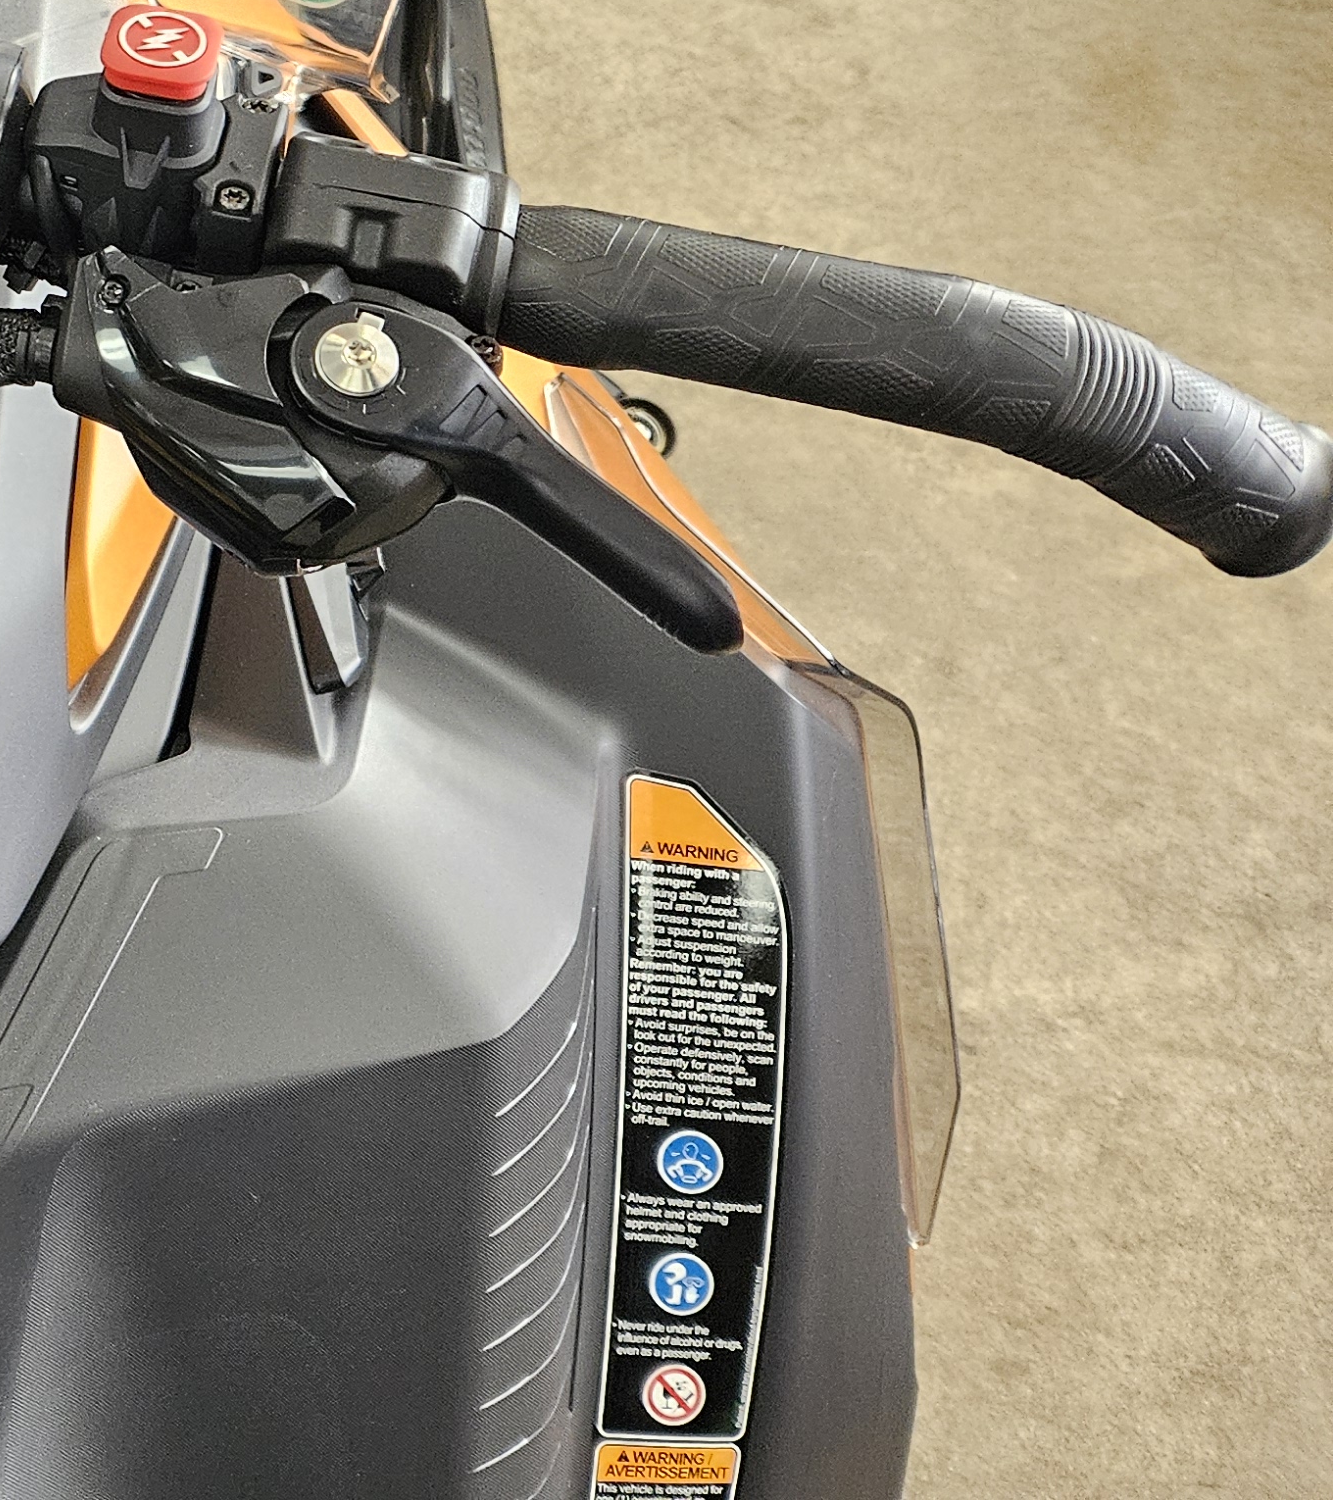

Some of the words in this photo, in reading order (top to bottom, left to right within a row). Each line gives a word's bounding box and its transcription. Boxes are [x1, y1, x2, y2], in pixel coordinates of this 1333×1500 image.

[658, 842, 738, 862] WARNING
[631, 860, 664, 873] When
[666, 863, 702, 878] riding
[703, 868, 729, 880] with
[631, 874, 695, 889] passenger:
[638, 886, 676, 900] Braking
[679, 891, 709, 905] ability
[711, 895, 731, 905] and
[733, 897, 774, 911] steering
[638, 898, 672, 910] control
[675, 903, 692, 912] are
[694, 904, 738, 917] reduced.
[667, 926, 700, 939] space
[702, 929, 713, 939] to
[691, 916, 724, 929] speed
[727, 920, 747, 930] and
[750, 922, 778, 934] allow
[636, 947, 688, 961] according
[691, 952, 702, 962] to
[704, 954, 743, 968] weight.
[673, 940, 736, 954] suspension
[629, 958, 695, 974] Remember:
[698, 967, 720, 978] you
[723, 969, 742, 979] are
[628, 980, 640, 991] of
[642, 984, 668, 995] your
[671, 987, 736, 1003] passenger.
[740, 992, 756, 1003] All
[629, 970, 696, 986] responsible
[699, 976, 715, 987] for
[718, 979, 738, 990] the
[740, 981, 776, 996] safety
[628, 993, 668, 1006] drivers
[671, 997, 694, 1008] and
[696, 1001, 764, 1017] passengers
[628, 1005, 657, 1016] must
[659, 1008, 686, 1019] read
[688, 1010, 707, 1021] the
[709, 1012, 767, 1029] following:
[634, 1018, 665, 1030] Avoid
[667, 1022, 720, 1036] surprises,
[723, 1027, 738, 1037] be
[740, 1030, 754, 1038] on
[757, 1030, 774, 1041] the
[634, 1030, 655, 1040] look
[658, 1033, 675, 1042] out
[677, 1033, 691, 1044] for
[694, 1035, 711, 1046] the
[713, 1038, 776, 1053] unexpected.
[634, 1041, 678, 1056] Operate
[746, 1054, 773, 1065] scan
[633, 1054, 688, 1070] constantly
[691, 1059, 705, 1070] for
[708, 1062, 748, 1076] people,
[633, 1066, 674, 1080] objects,
[677, 1070, 733, 1084] conditions
[735, 1075, 756, 1086] and
[633, 1078, 685, 1093] upcoming
[688, 1083, 734, 1096] vehicles.
[632, 1089, 662, 1101] Avoid
[664, 1092, 684, 1103] thin
[687, 1094, 703, 1105] ice
[711, 1098, 739, 1110] open
[741, 1100, 774, 1112] water.
[632, 1102, 652, 1113] Use
[655, 1105, 681, 1116] extra
[683, 1108, 721, 1120] caution
[723, 1111, 773, 1124] whenever
[627, 1192, 665, 1207] Always
[667, 1197, 694, 1208] wear
[696, 1199, 710, 1209] an
[712, 1200, 761, 1215] approved
[626, 1205, 661, 1217] helmet
[664, 1208, 684, 1220] and
[686, 1210, 727, 1225] clothing
[633, 1451, 704, 1465] WARNING
[605, 1464, 730, 1480] AVERTISSEMENT
[597, 1482, 616, 1493] This
[619, 1482, 653, 1494] vehicle
[655, 1484, 664, 1494] is
[665, 1485, 708, 1497] designed
[709, 1485, 723, 1494] for
